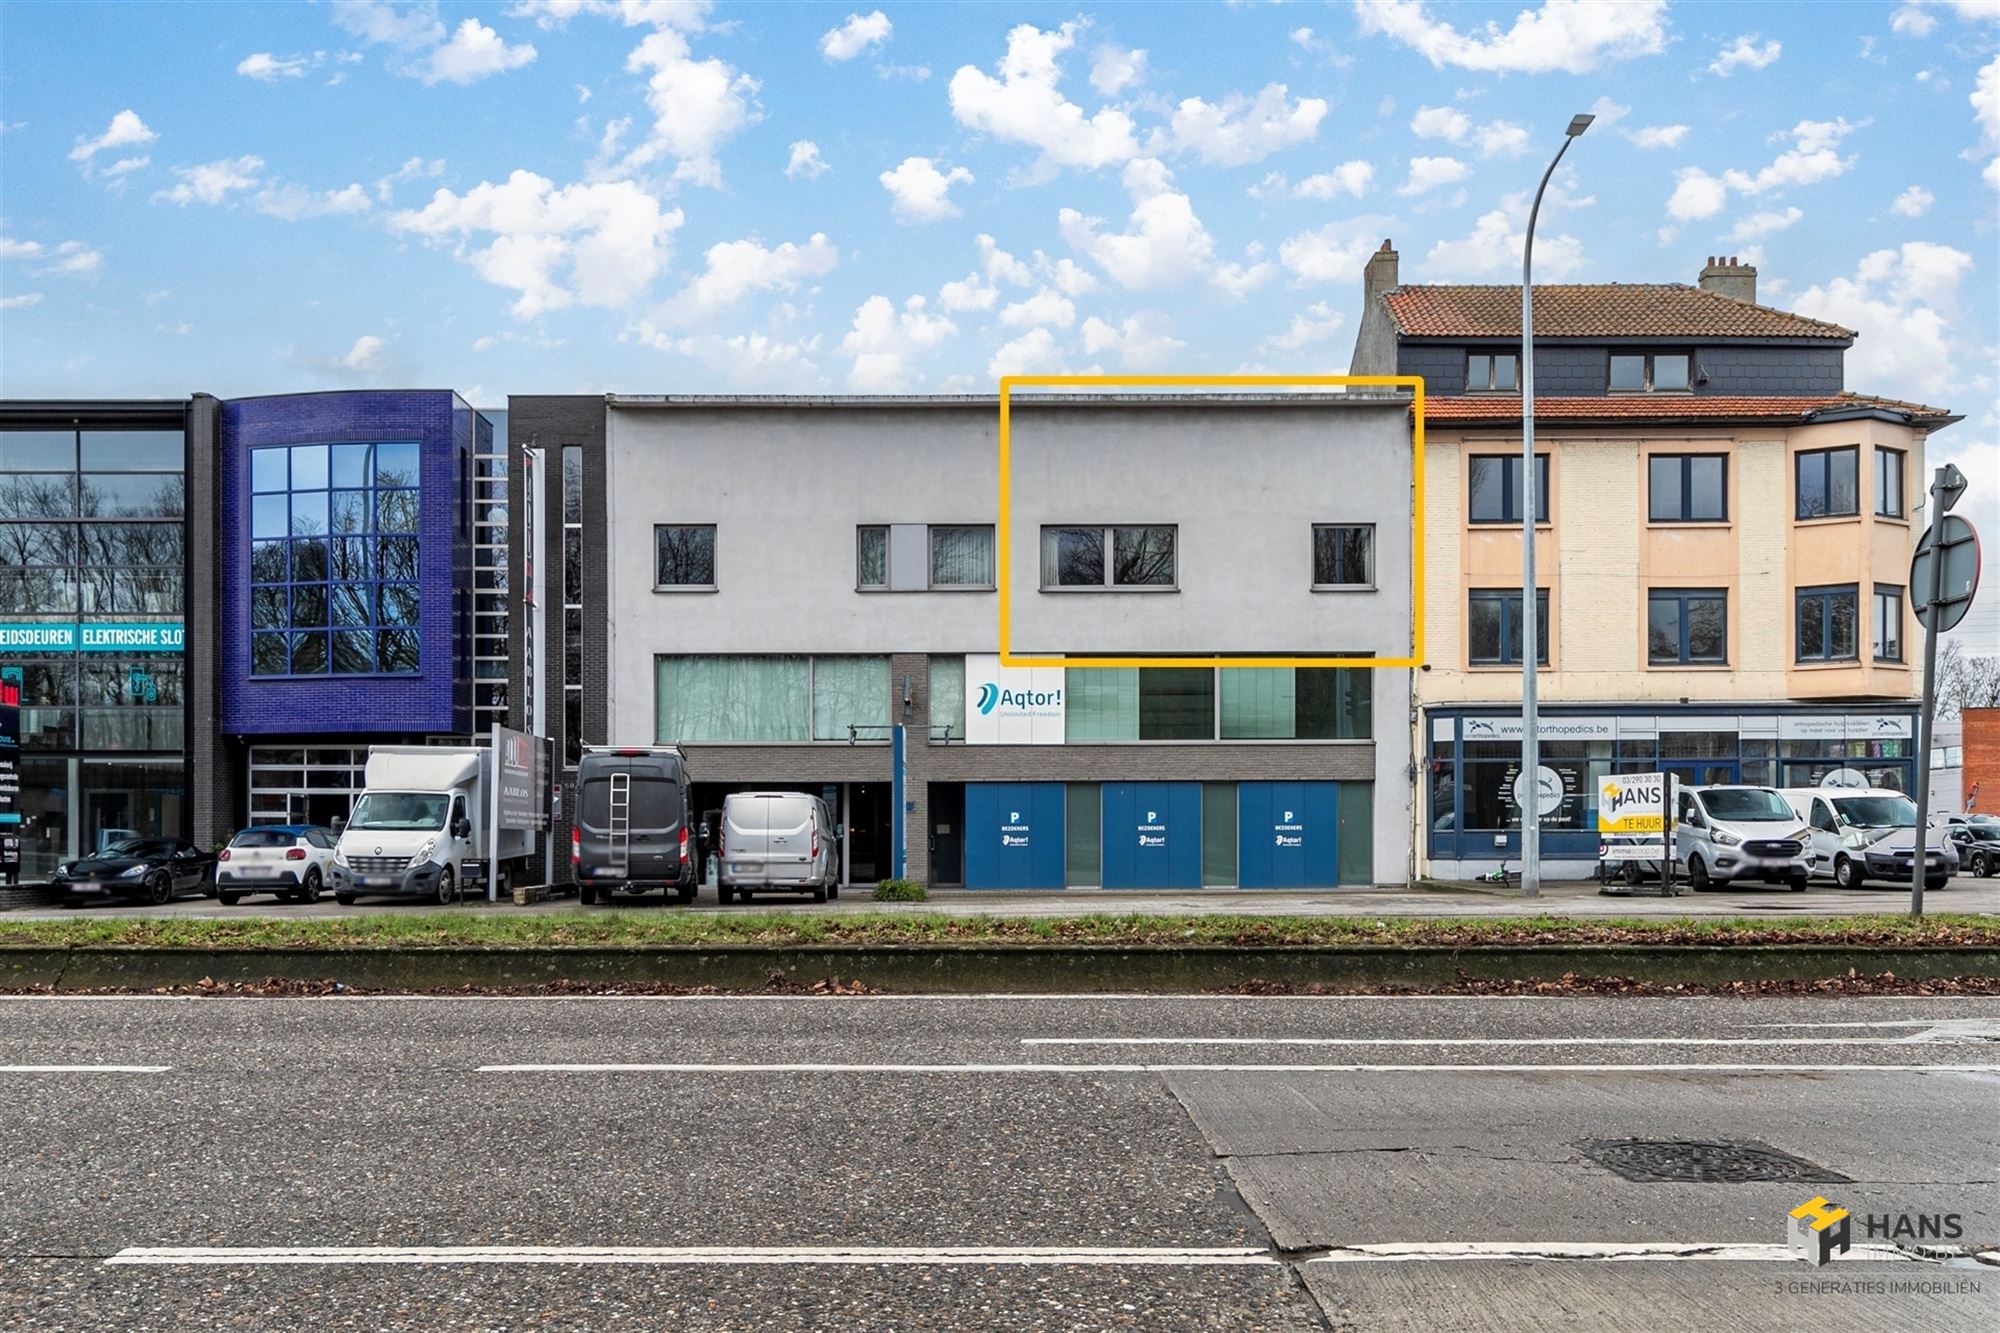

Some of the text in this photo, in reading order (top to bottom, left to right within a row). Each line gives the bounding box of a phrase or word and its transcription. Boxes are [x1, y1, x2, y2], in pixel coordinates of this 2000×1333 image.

[83, 629, 157, 644] ELEKTRISCHE
[161, 629, 184, 644] SLO
[1001, 689, 1061, 710] Aqtor!
[1622, 776, 1644, 784] 03/290
[1653, 775, 1661, 783] 30
[1611, 787, 1661, 812] HANS
[1011, 811, 1020, 823] P
[1148, 811, 1156, 823] P
[1284, 811, 1294, 823] P
[1624, 817, 1662, 829] TE HUUR
